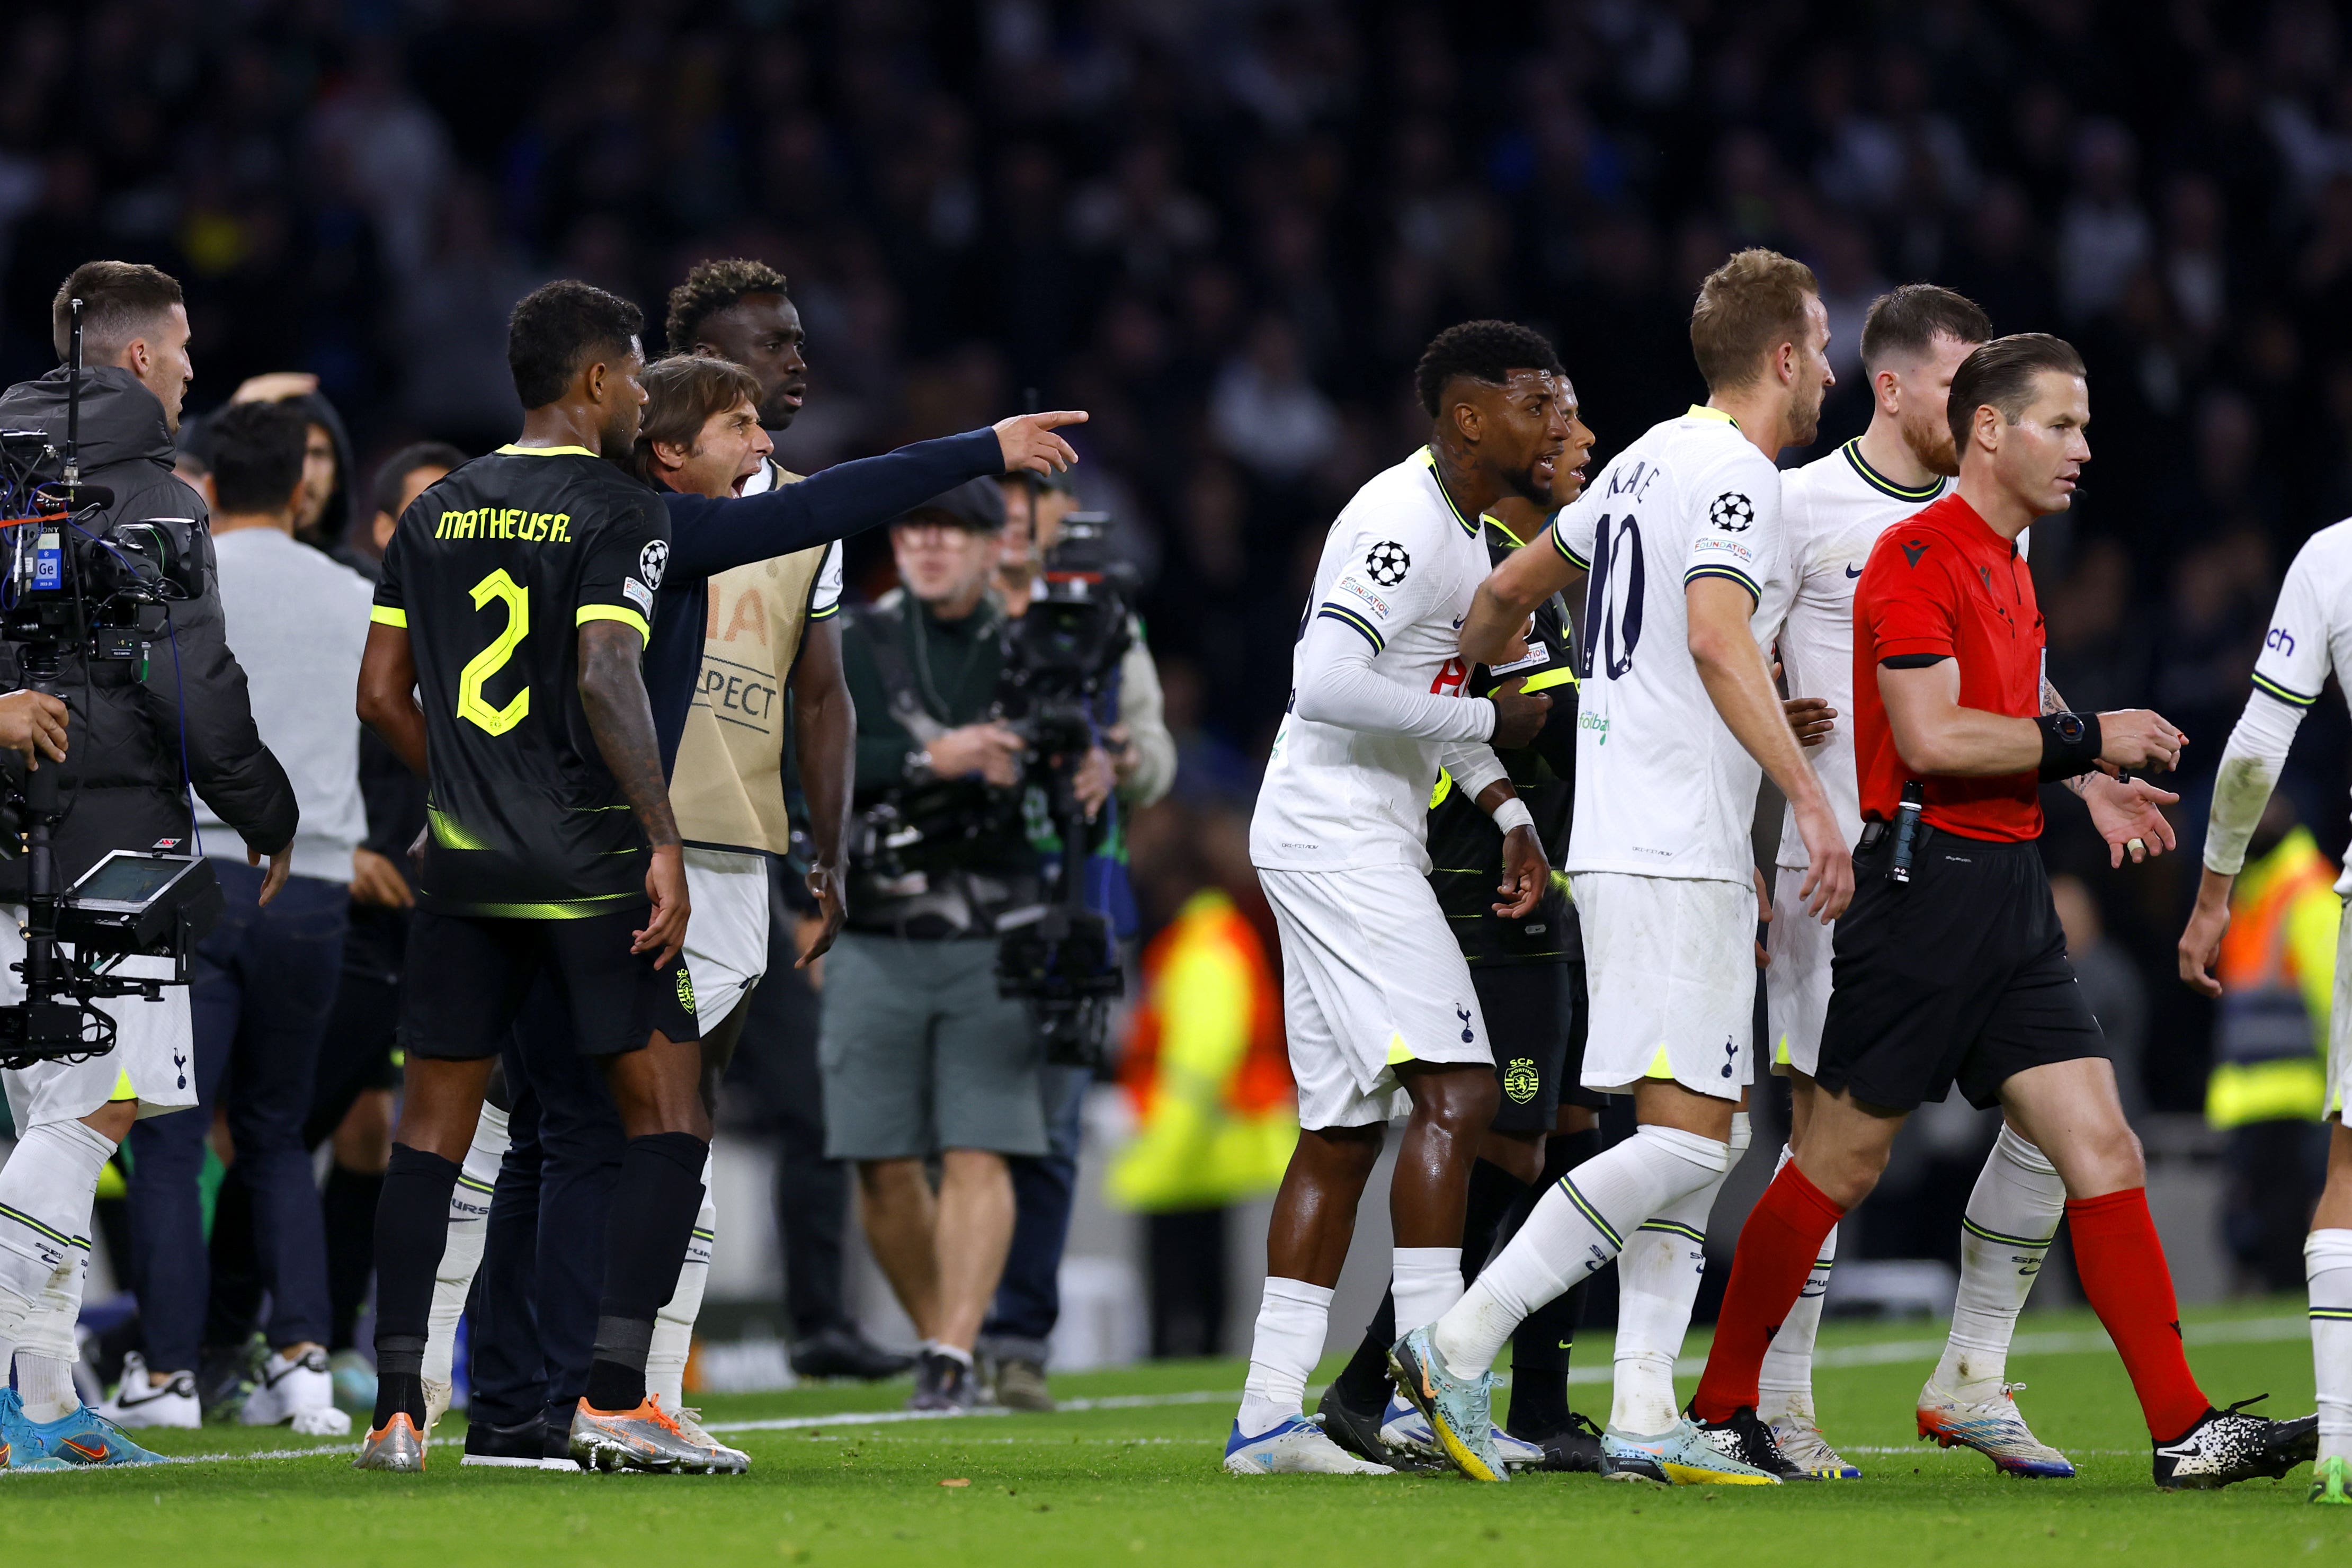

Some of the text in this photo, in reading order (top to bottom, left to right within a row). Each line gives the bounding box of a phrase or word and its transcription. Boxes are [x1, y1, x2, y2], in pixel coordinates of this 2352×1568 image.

[1606, 461, 1660, 504] KAE
[1695, 541, 1752, 559] FOUNDATION
[39, 563, 54, 575] Ge
[1340, 580, 1389, 616] FOUNDATION
[1580, 514, 1645, 681] 10
[457, 567, 529, 737] 2
[676, 968, 688, 978] SCP
[1510, 1058, 1534, 1067] SCP
[1508, 1068, 1535, 1078] SPORTING
